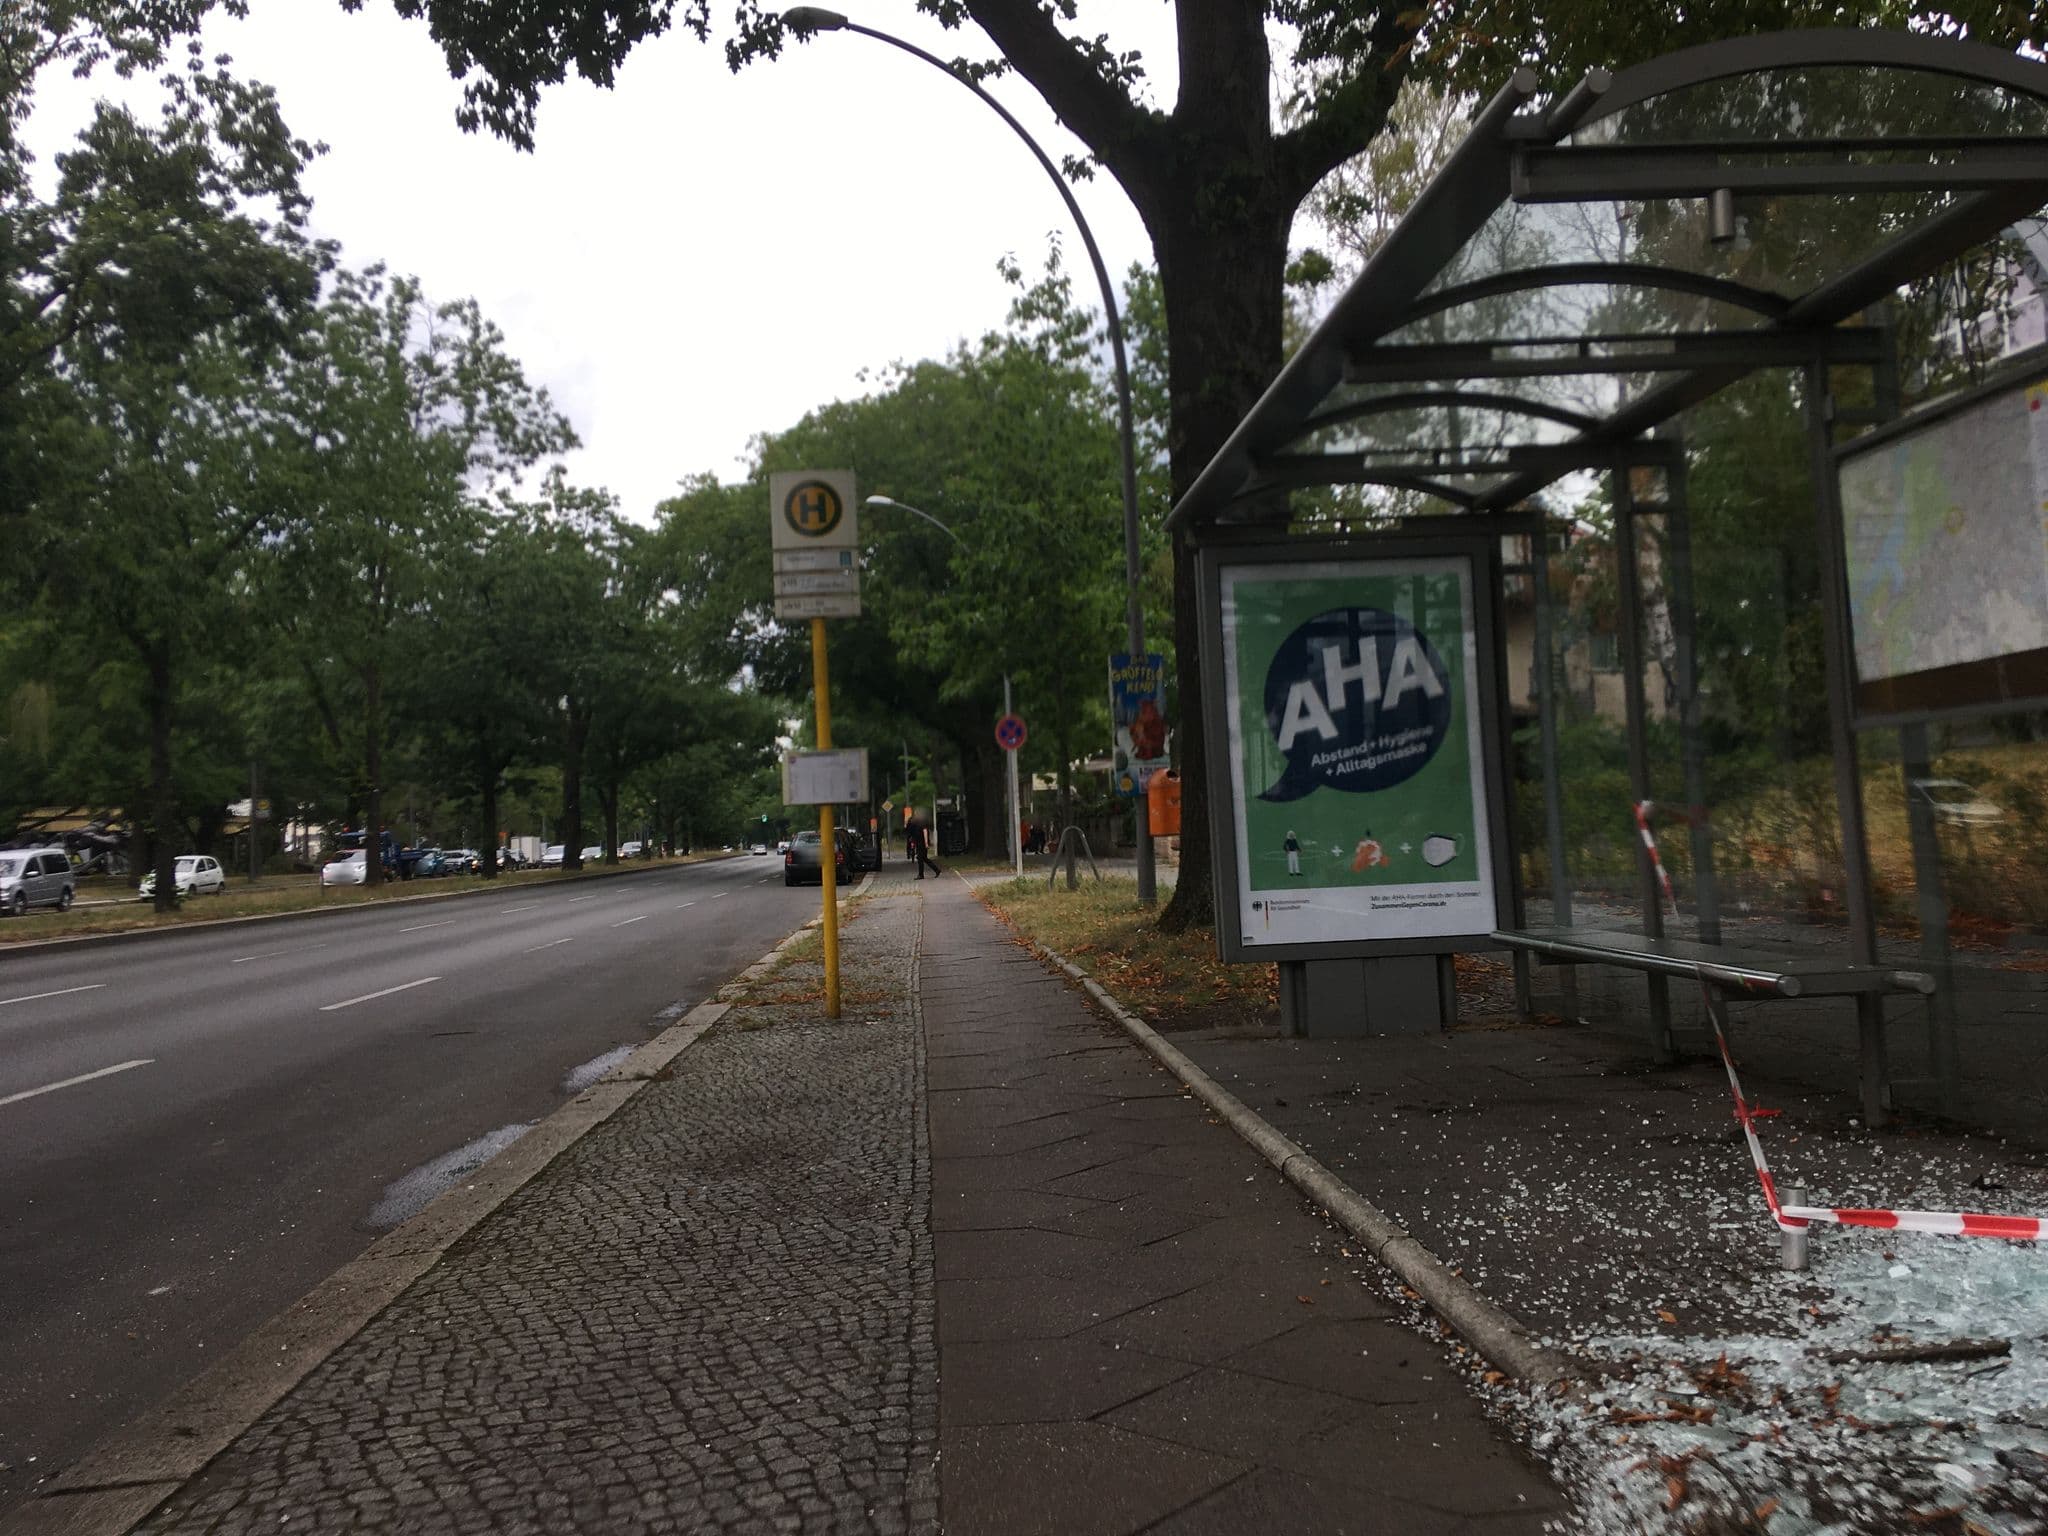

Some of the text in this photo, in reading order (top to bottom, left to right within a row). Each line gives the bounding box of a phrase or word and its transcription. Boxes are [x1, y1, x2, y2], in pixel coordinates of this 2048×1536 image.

[799, 493, 827, 524] H
[1277, 635, 1445, 752] AHA
[1310, 740, 1368, 768] Abstand
[1377, 725, 1434, 750] Hygiene
[1335, 743, 1428, 777] Alltagsmaske
